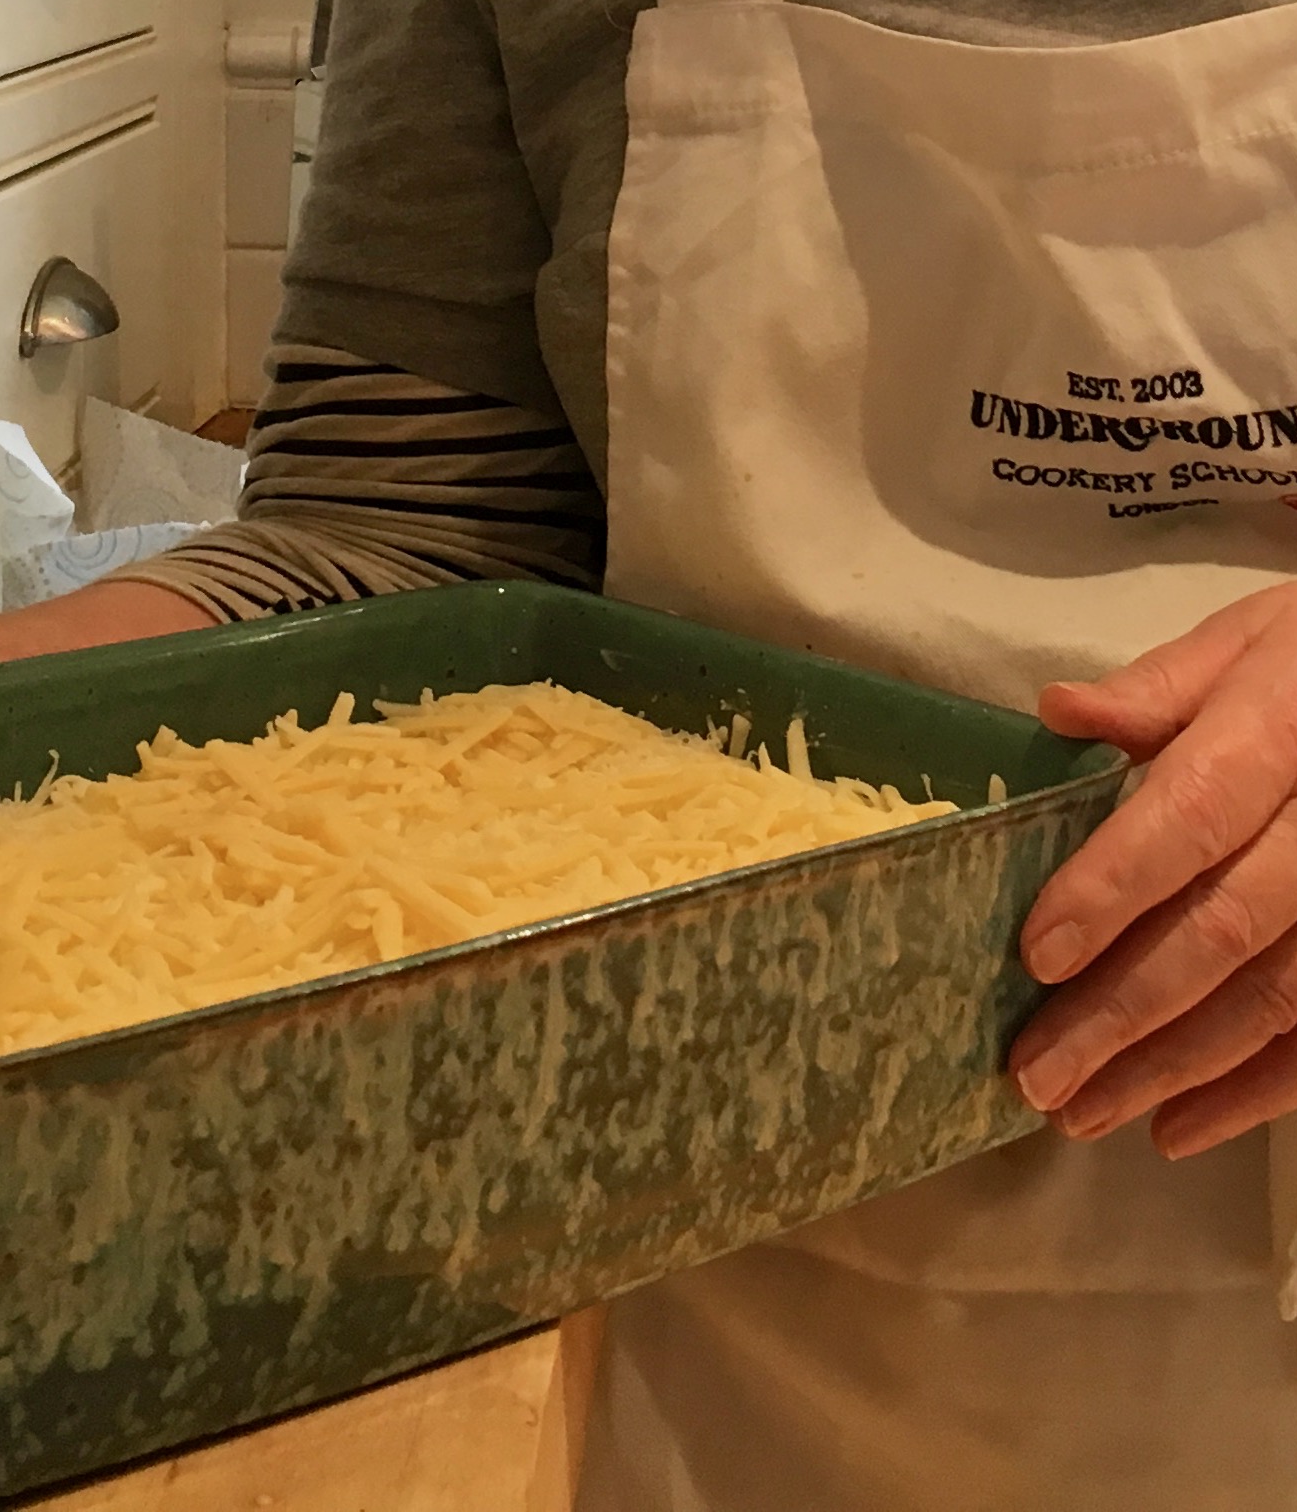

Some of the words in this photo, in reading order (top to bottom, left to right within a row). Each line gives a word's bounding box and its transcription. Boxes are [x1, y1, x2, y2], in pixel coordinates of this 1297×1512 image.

[1066, 371, 1125, 403] EST.
[1131, 369, 1205, 403] 2003
[991, 458, 1156, 493] COOKERY
